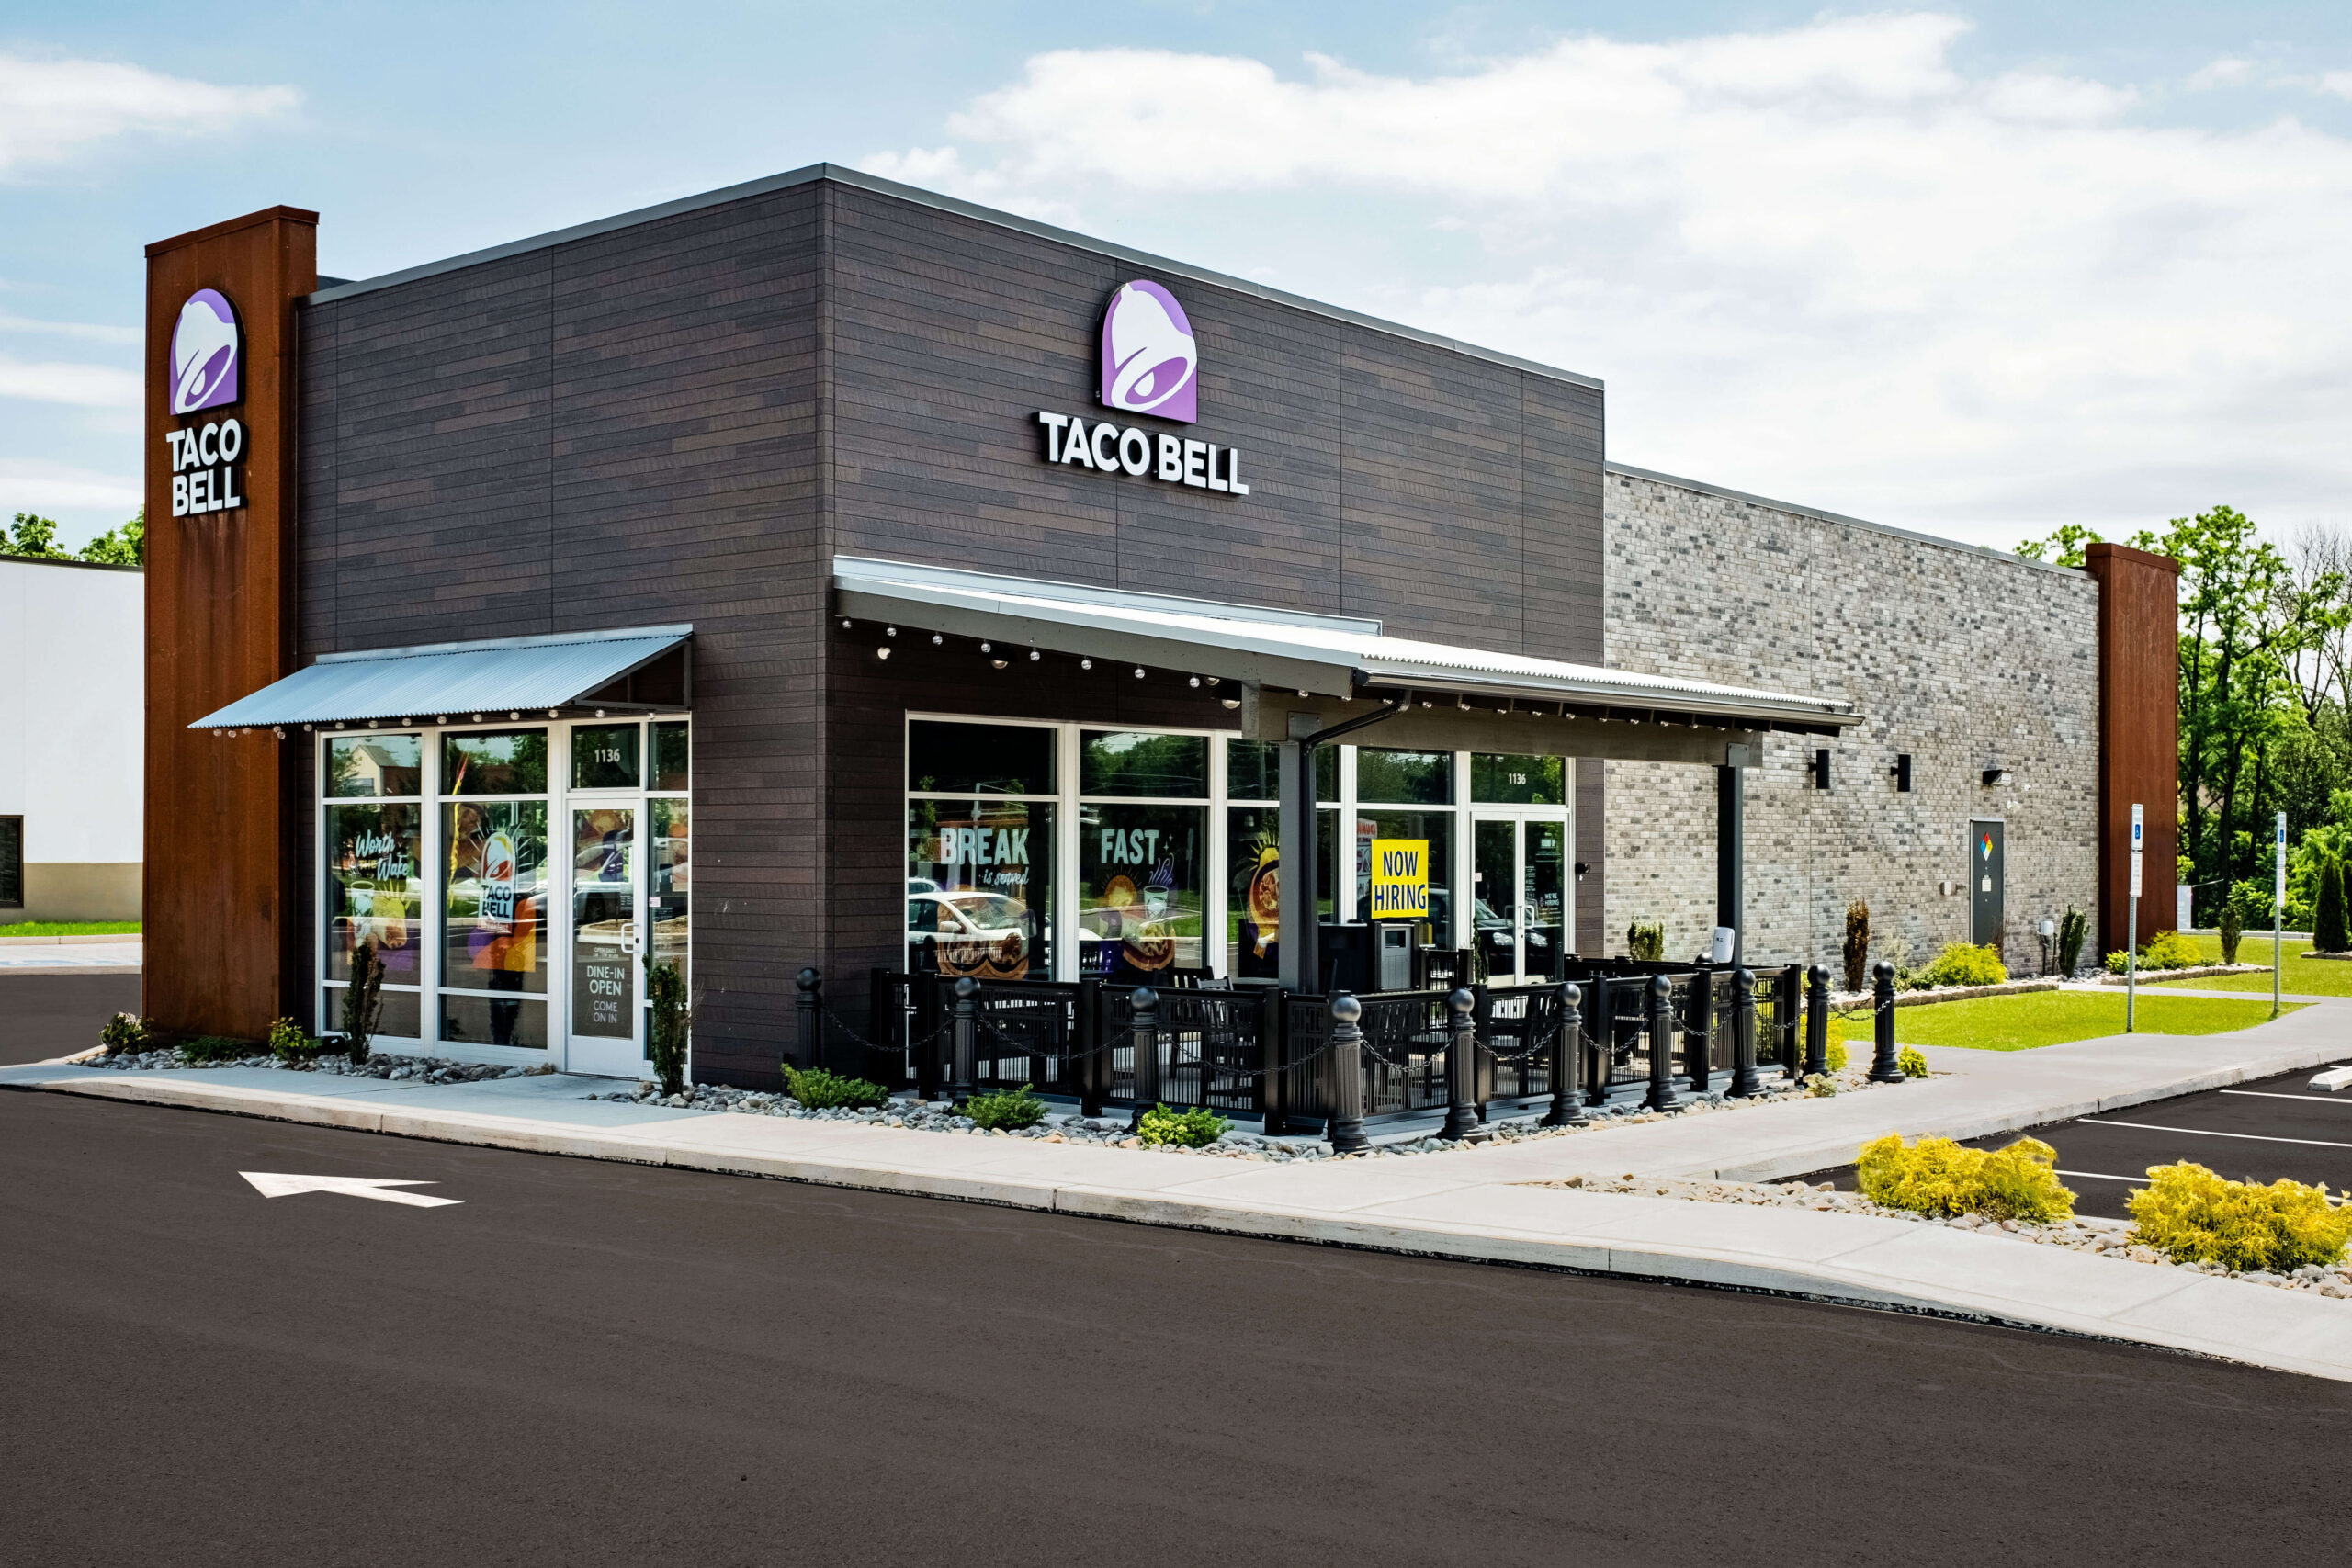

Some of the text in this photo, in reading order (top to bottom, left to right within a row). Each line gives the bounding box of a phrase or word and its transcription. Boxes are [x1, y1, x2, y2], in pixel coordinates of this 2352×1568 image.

[166, 418, 242, 472] TACO
[1039, 411, 1250, 495] TACO BELL
[173, 466, 241, 517] BELL
[594, 748, 621, 763] 1136
[1508, 773, 1526, 785] 1136
[356, 829, 395, 857] Worth
[940, 827, 1030, 865] BREAK
[1101, 828, 1159, 865] FAST
[377, 853, 409, 882] Wake
[1383, 851, 1419, 877] NOW
[983, 866, 1029, 886] is served
[481, 885, 512, 902] TACO
[1374, 883, 1426, 911] HIRING
[482, 900, 510, 919] BELL
[587, 964, 625, 980] DINE-IN
[589, 978, 622, 997] OPEN
[593, 1011, 617, 1024] ON IN
[594, 1000, 617, 1012] COME
